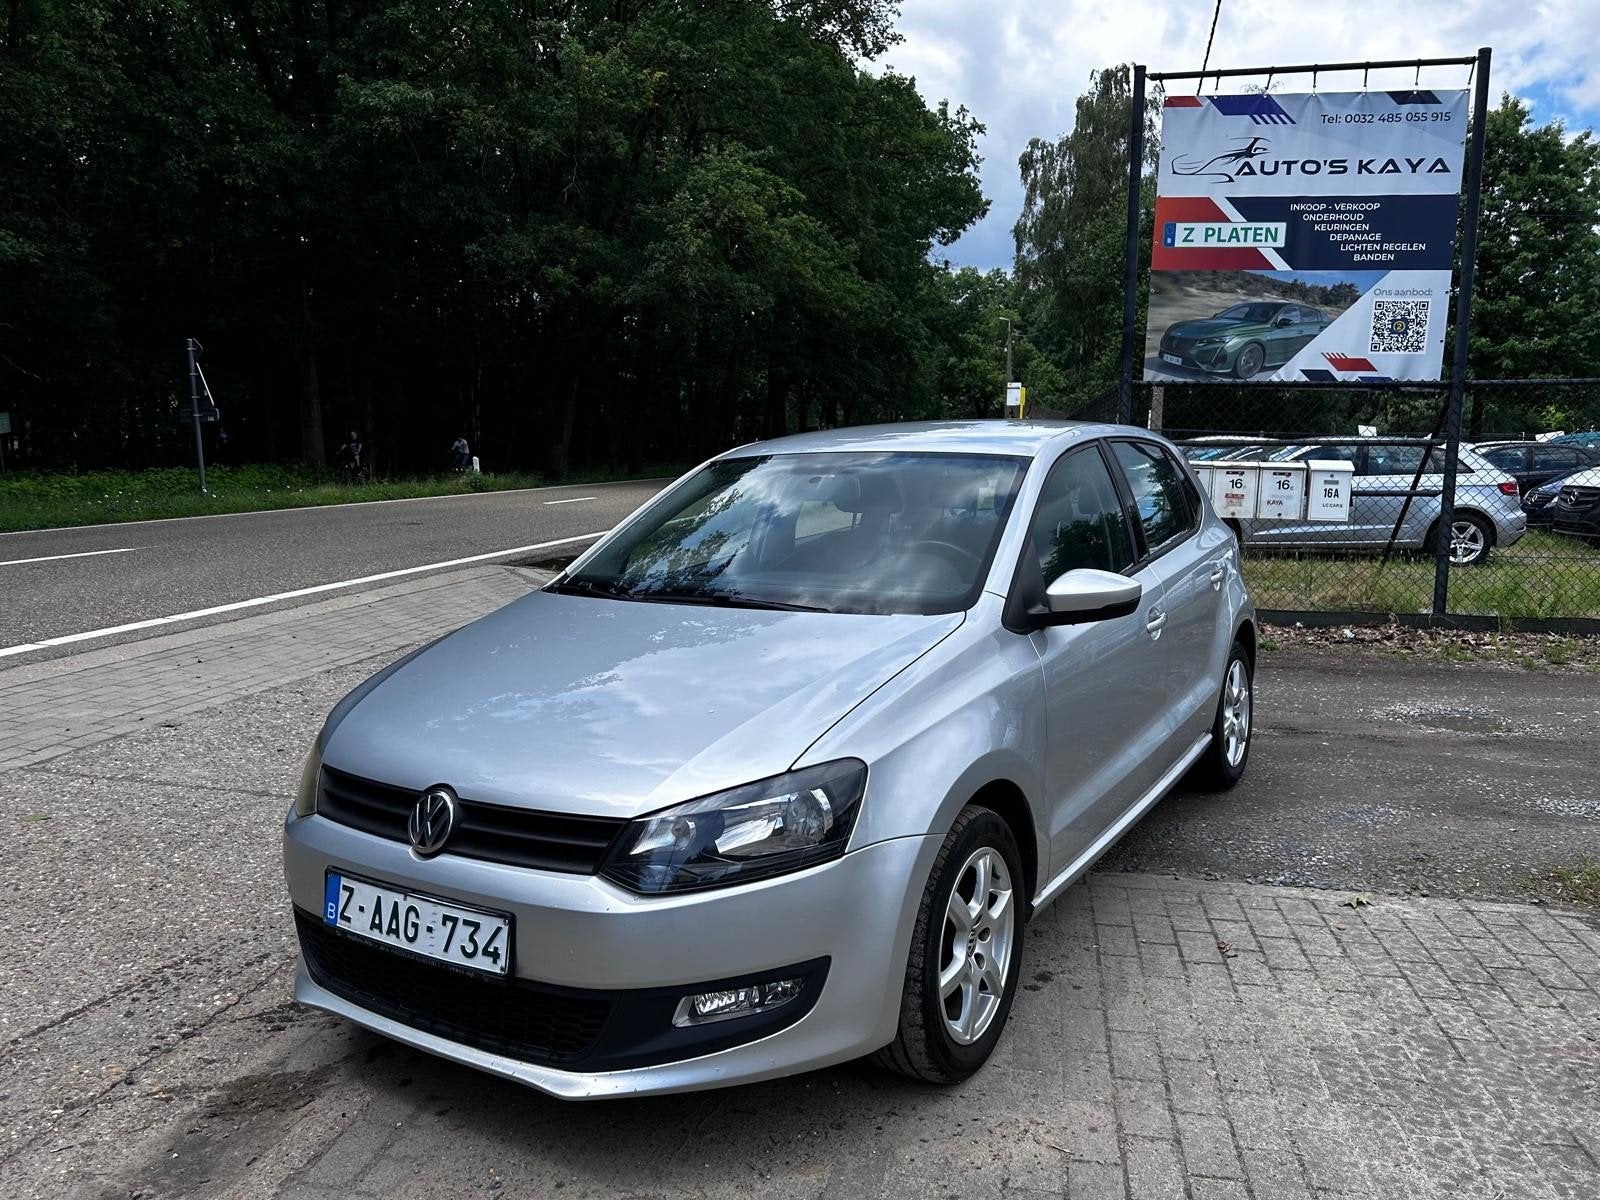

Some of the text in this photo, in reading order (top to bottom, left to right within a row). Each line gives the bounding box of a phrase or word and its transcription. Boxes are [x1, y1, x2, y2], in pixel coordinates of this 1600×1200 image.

[1321, 111, 1452, 124] Tel: 0032 485 055 915
[1234, 157, 1451, 176] AUTO'S KAYA
[1290, 203, 1326, 211] INKOOP
[1334, 202, 1381, 211] VERKOOP
[1302, 213, 1364, 221] ONDERHOUD
[1314, 223, 1369, 231] KEURINGEN
[1181, 227, 1195, 243] Z
[1204, 227, 1279, 243] PLATEN
[1329, 233, 1382, 241] DEPANAGE
[1340, 243, 1426, 251] LICHTEN REGELEN
[1353, 253, 1395, 261] BANDEN
[1373, 287, 1433, 296] Ons aanbod:
[1323, 488, 1339, 499] 16A
[327, 902, 336, 919] B
[339, 884, 503, 965] Z-AAG-734
